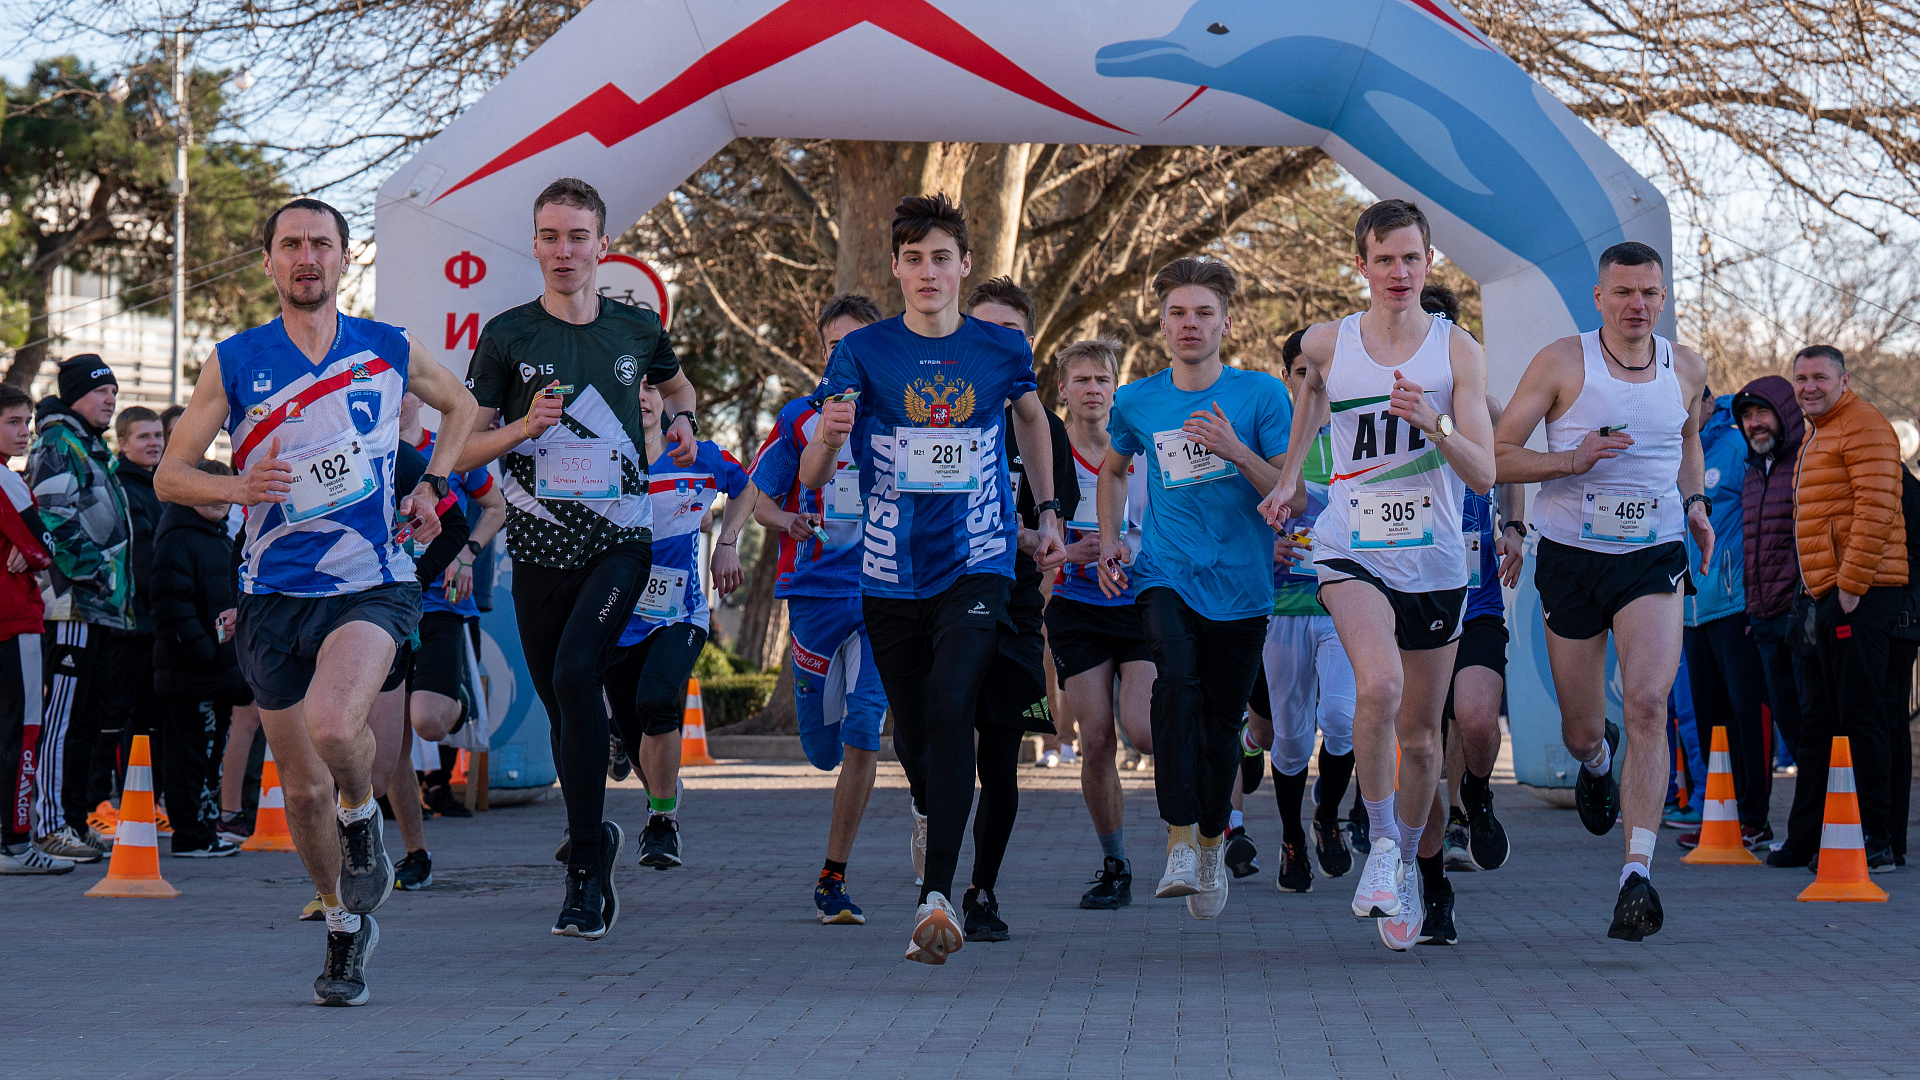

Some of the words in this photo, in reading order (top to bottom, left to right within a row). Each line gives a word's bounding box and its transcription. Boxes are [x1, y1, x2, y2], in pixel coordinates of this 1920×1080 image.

[539, 364, 554, 375] 15
[561, 457, 592, 471] 550
[931, 444, 963, 464] 281
[310, 454, 350, 484] 182
[862, 434, 900, 583] RUSSIA
[1381, 501, 1415, 522] 305
[1615, 502, 1645, 519] 465
[17, 750, 36, 826] adidas
